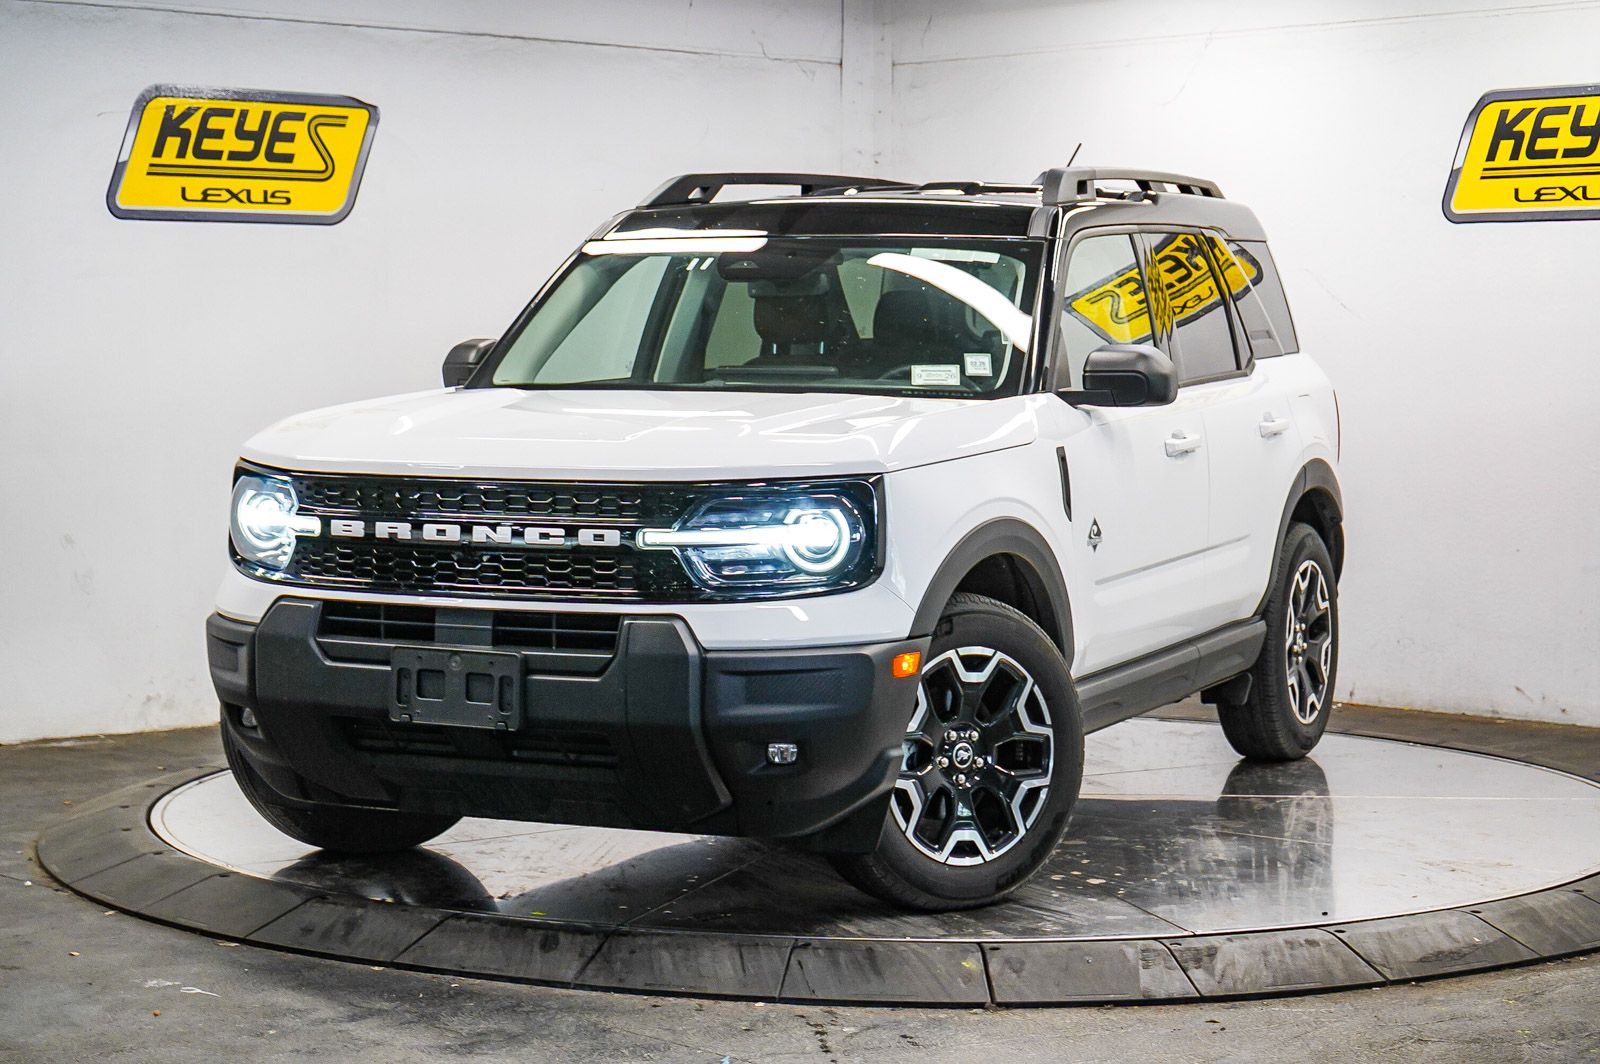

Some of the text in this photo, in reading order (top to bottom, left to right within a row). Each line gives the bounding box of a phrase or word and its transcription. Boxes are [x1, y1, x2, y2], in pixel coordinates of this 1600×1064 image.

[150, 104, 348, 182] KEYES
[181, 186, 291, 205] LEXUS
[330, 519, 621, 547] BRONCO
